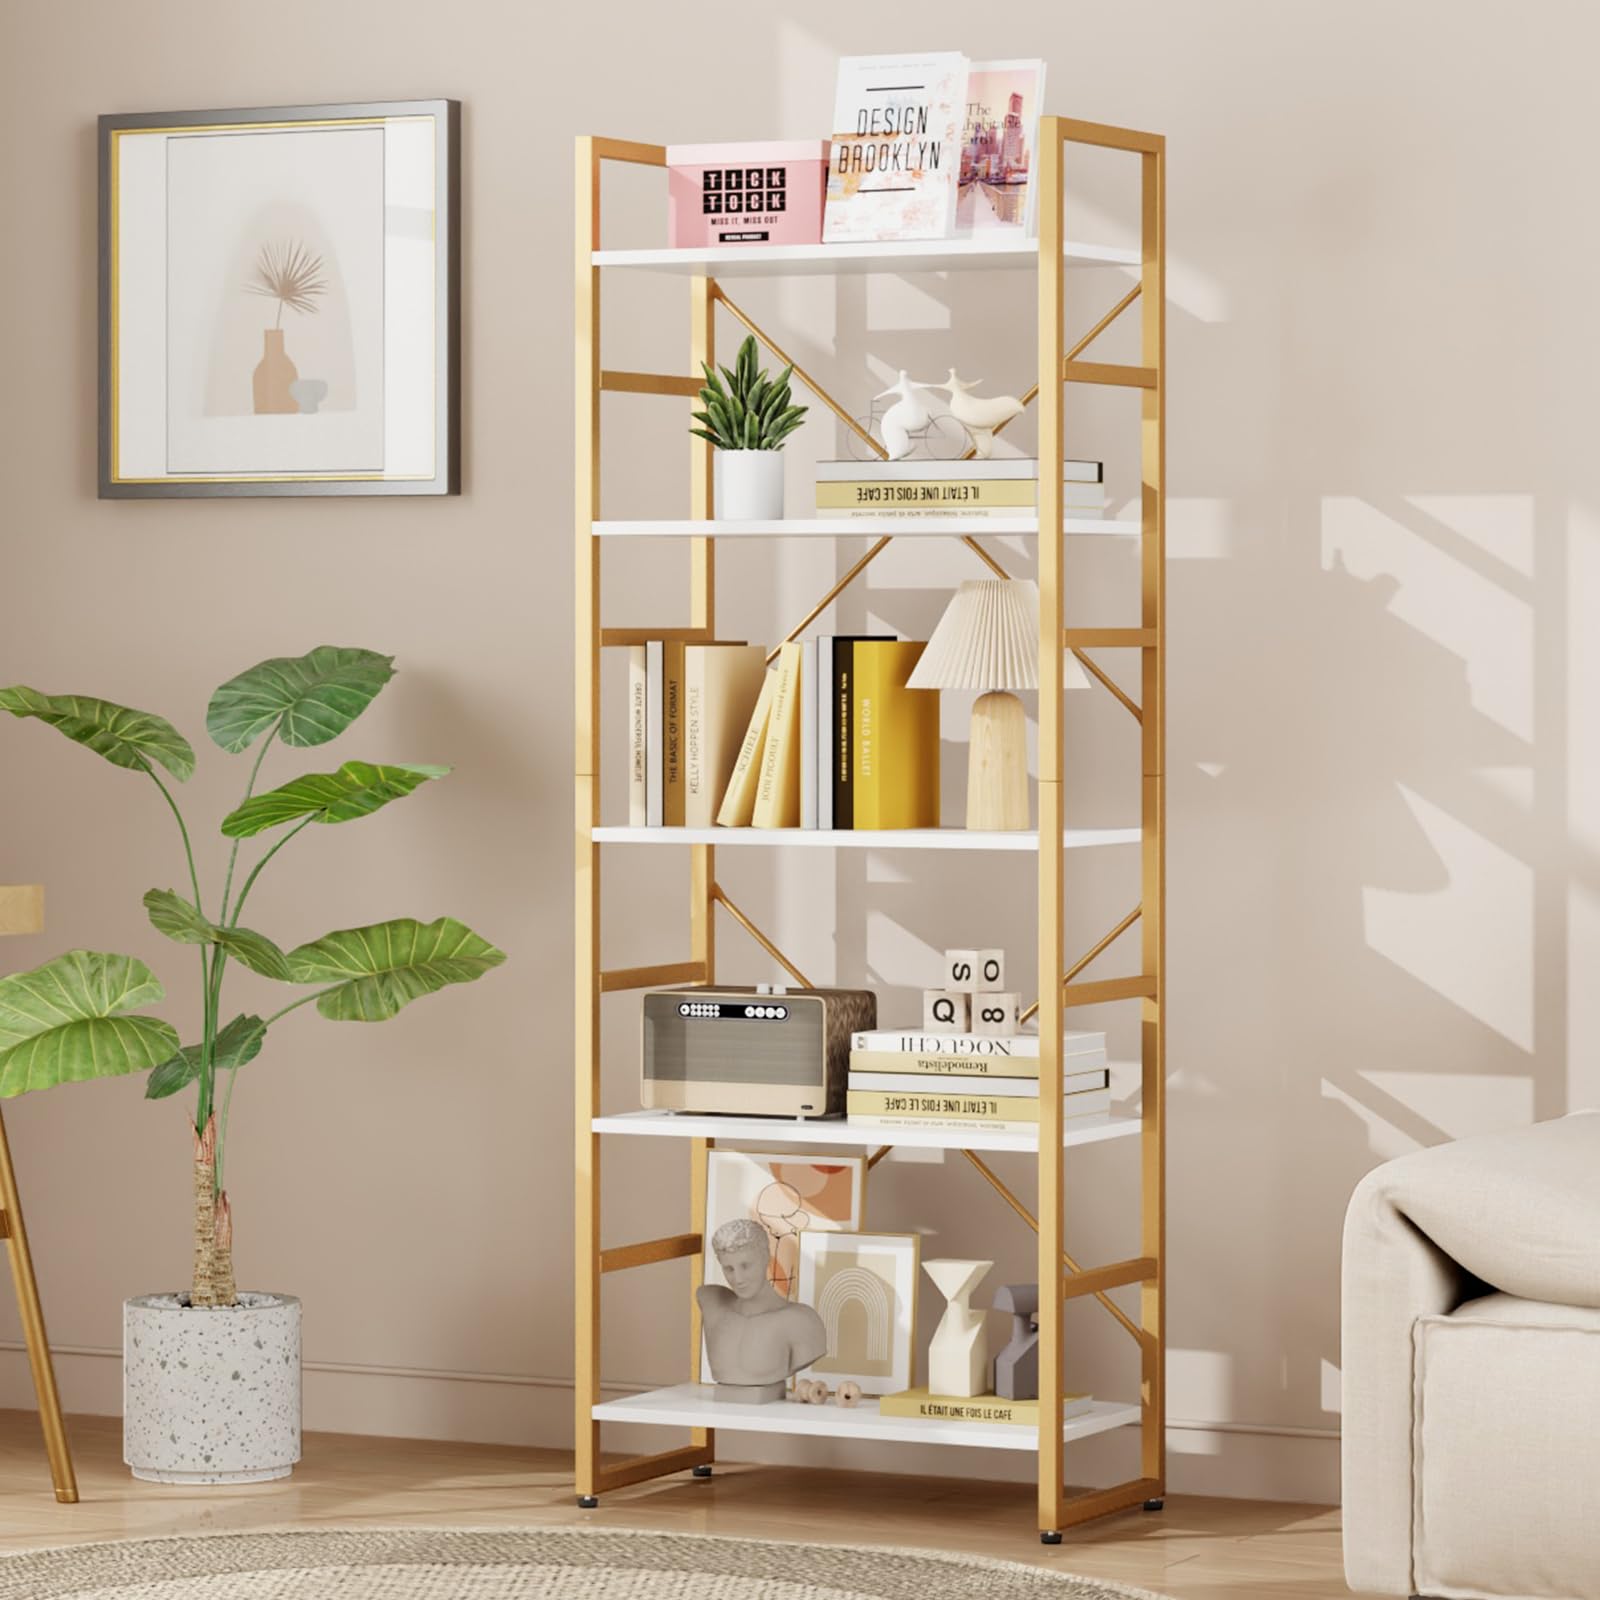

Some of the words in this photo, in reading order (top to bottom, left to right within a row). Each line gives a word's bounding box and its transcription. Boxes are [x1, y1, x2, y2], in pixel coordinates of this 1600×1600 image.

[965, 101, 993, 116] The
[857, 105, 929, 138] DESIGN
[838, 141, 941, 174] BROOKLYN
[706, 170, 783, 189] TICK
[706, 192, 783, 211] TOCK
[711, 217, 729, 226] MISS
[743, 216, 762, 225] MISS
[764, 215, 778, 224] OUT
[857, 487, 881, 504] CAFÉ
[883, 487, 895, 501] LE
[897, 487, 918, 501] FOIS
[921, 486, 940, 501] UNE
[942, 485, 968, 502] ÉTAIT
[971, 485, 980, 501] IL
[669, 680, 678, 719] FORMAT
[690, 687, 699, 717] STYLE
[861, 698, 872, 736] WORLD
[669, 722, 678, 734] OF
[690, 720, 699, 760] HOPPEN
[669, 737, 678, 764] BASIC
[669, 767, 678, 785] THE
[690, 763, 699, 794] KELLY
[952, 962, 971, 982] S
[932, 998, 955, 1025] Q
[901, 1037, 1011, 1056] NOGUCHI
[918, 1059, 988, 1073] Remodelista
[909, 1098, 920, 1111] LE
[921, 1098, 941, 1112] FOIS
[943, 1099, 961, 1113] UNE
[990, 1101, 998, 1114] IL
[920, 1404, 927, 1416] IL
[928, 1402, 948, 1416] ÉTAIT
[949, 1406, 964, 1417] UNE
[965, 1407, 982, 1419] FOIS
[983, 1408, 992, 1419] LE
